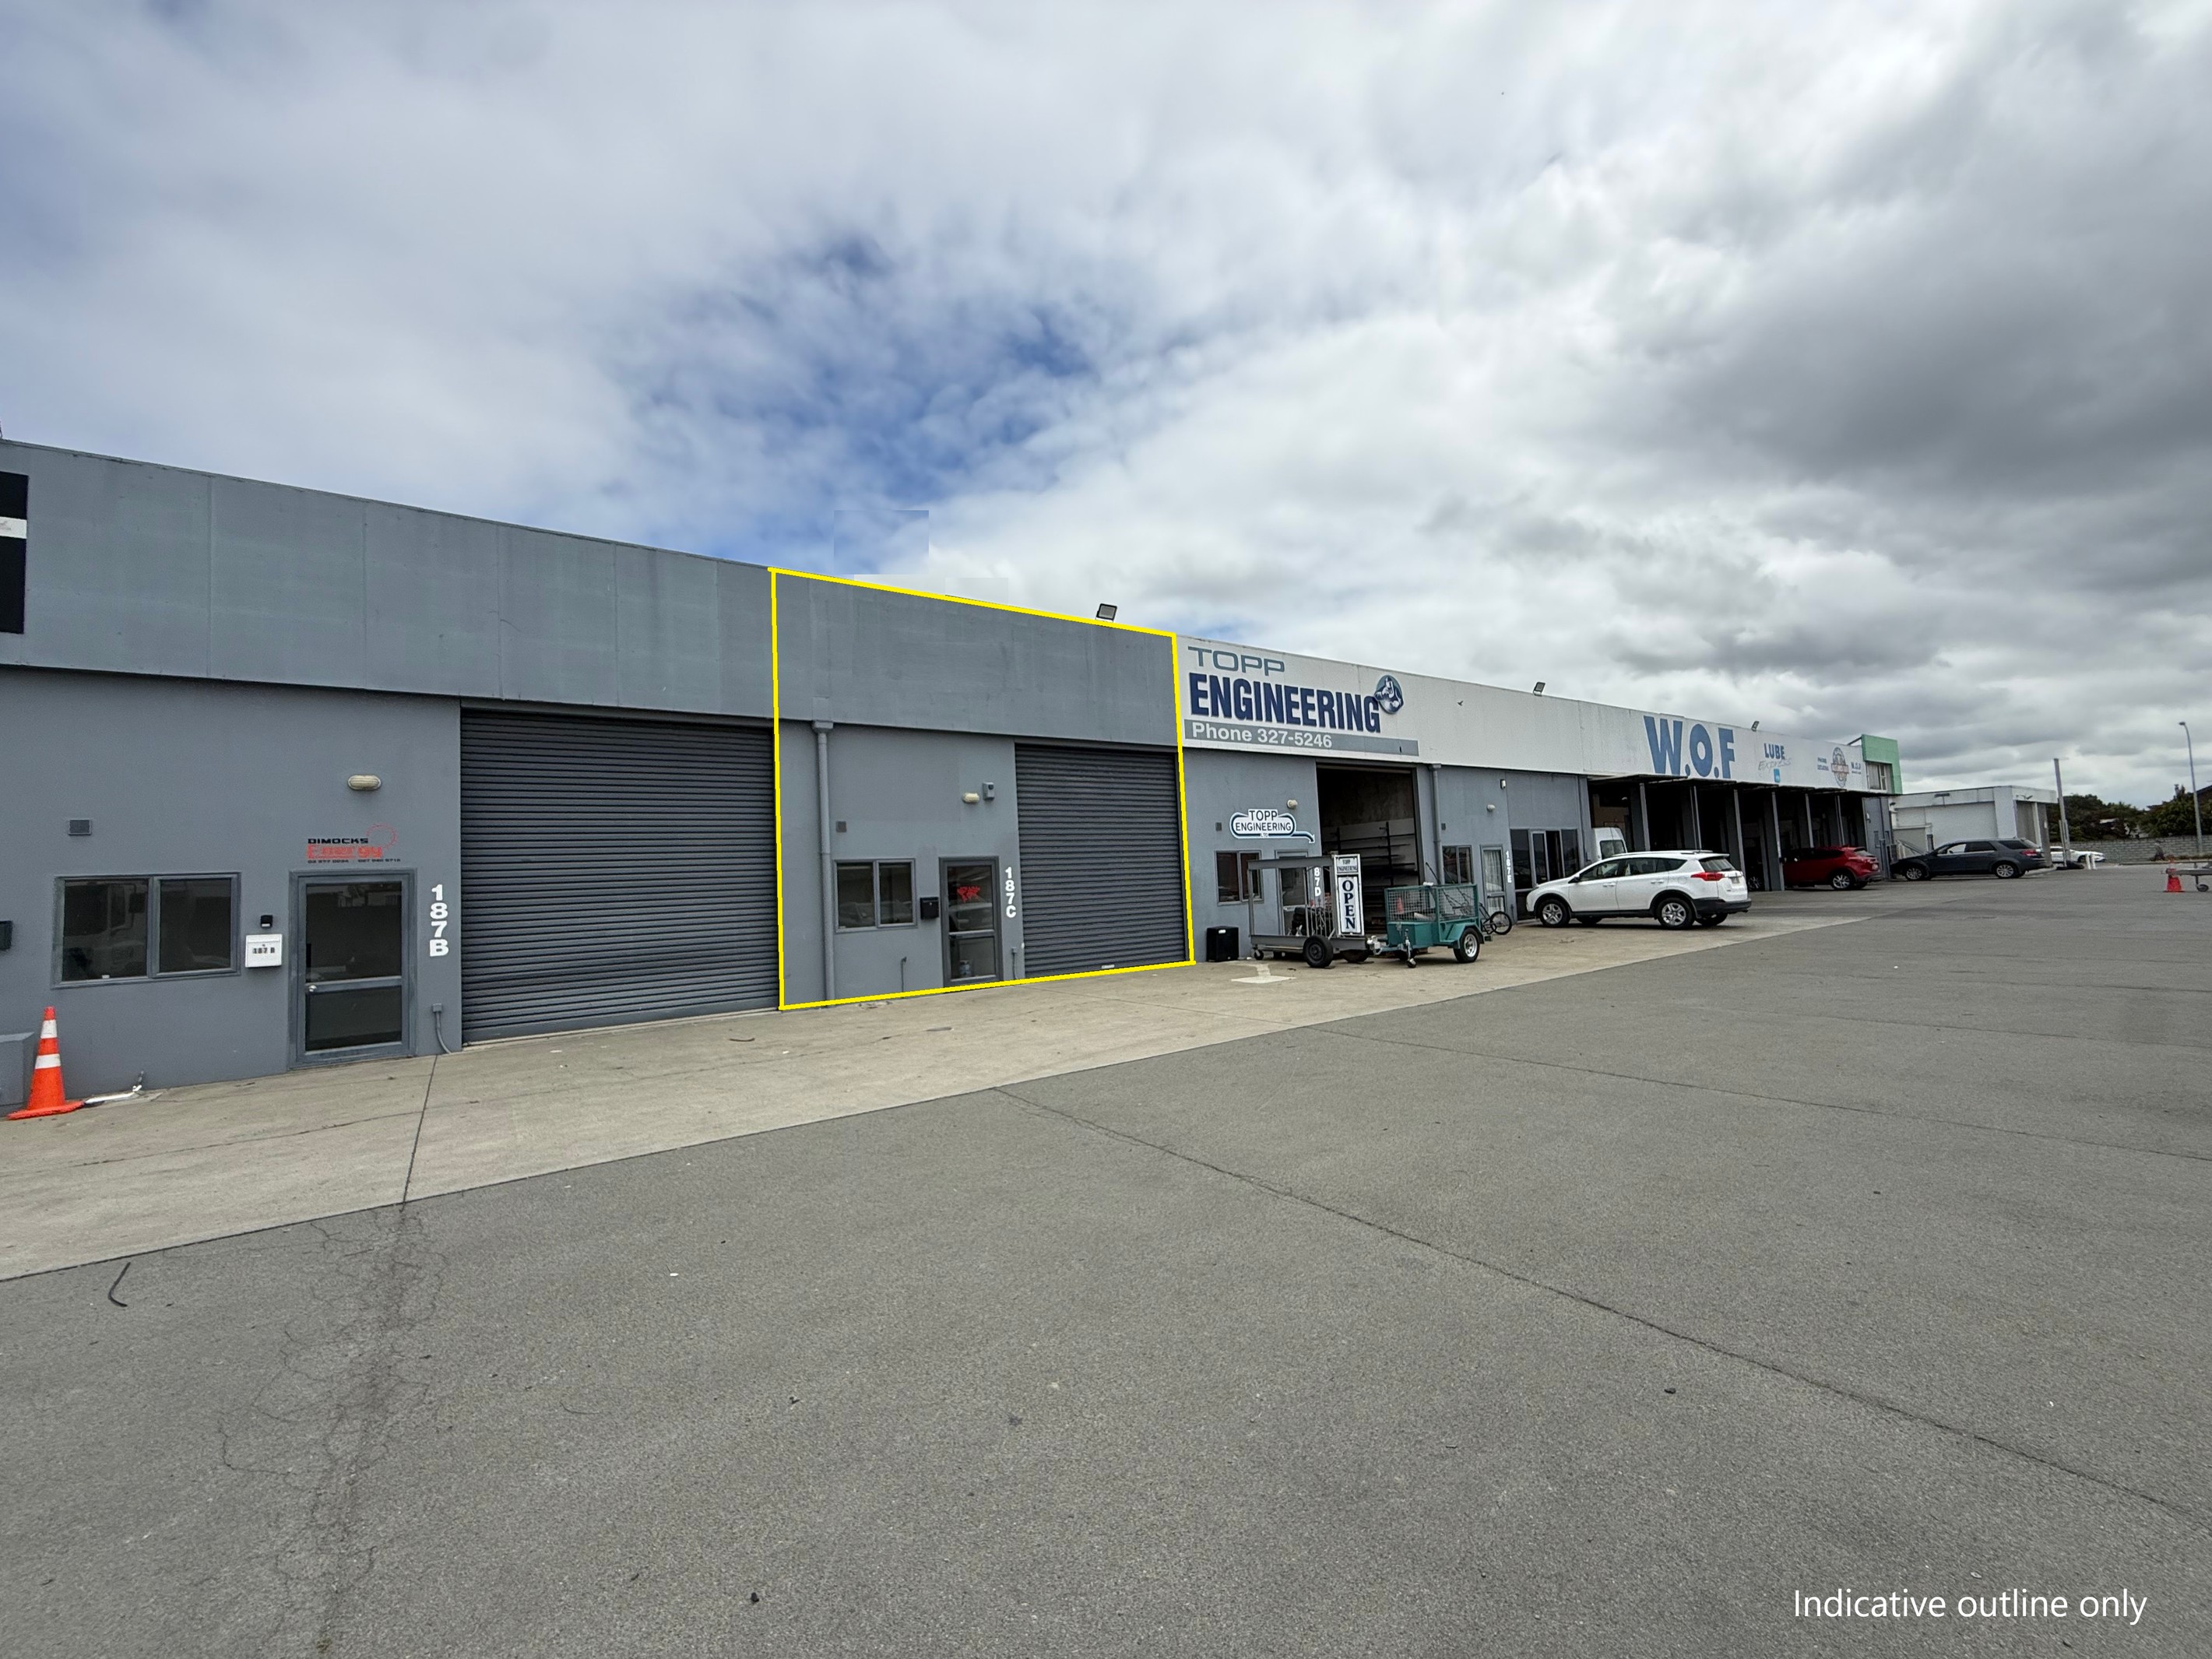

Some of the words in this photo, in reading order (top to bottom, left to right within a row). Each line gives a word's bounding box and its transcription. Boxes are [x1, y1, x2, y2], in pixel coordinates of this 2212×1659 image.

[1188, 646, 1285, 677] TOPP
[1189, 672, 1381, 733] ENGINEERING
[1192, 722, 1253, 742] Phone
[1257, 728, 1332, 748] 327-5246
[1643, 715, 1735, 779] W.O.F
[1764, 743, 1785, 760] LUBE
[1235, 822, 1292, 831] ENGINEERING
[1249, 810, 1278, 821] TOPP
[1005, 866, 1017, 918] 187C
[1342, 880, 1356, 930] OPEN
[430, 884, 449, 957] 187B
